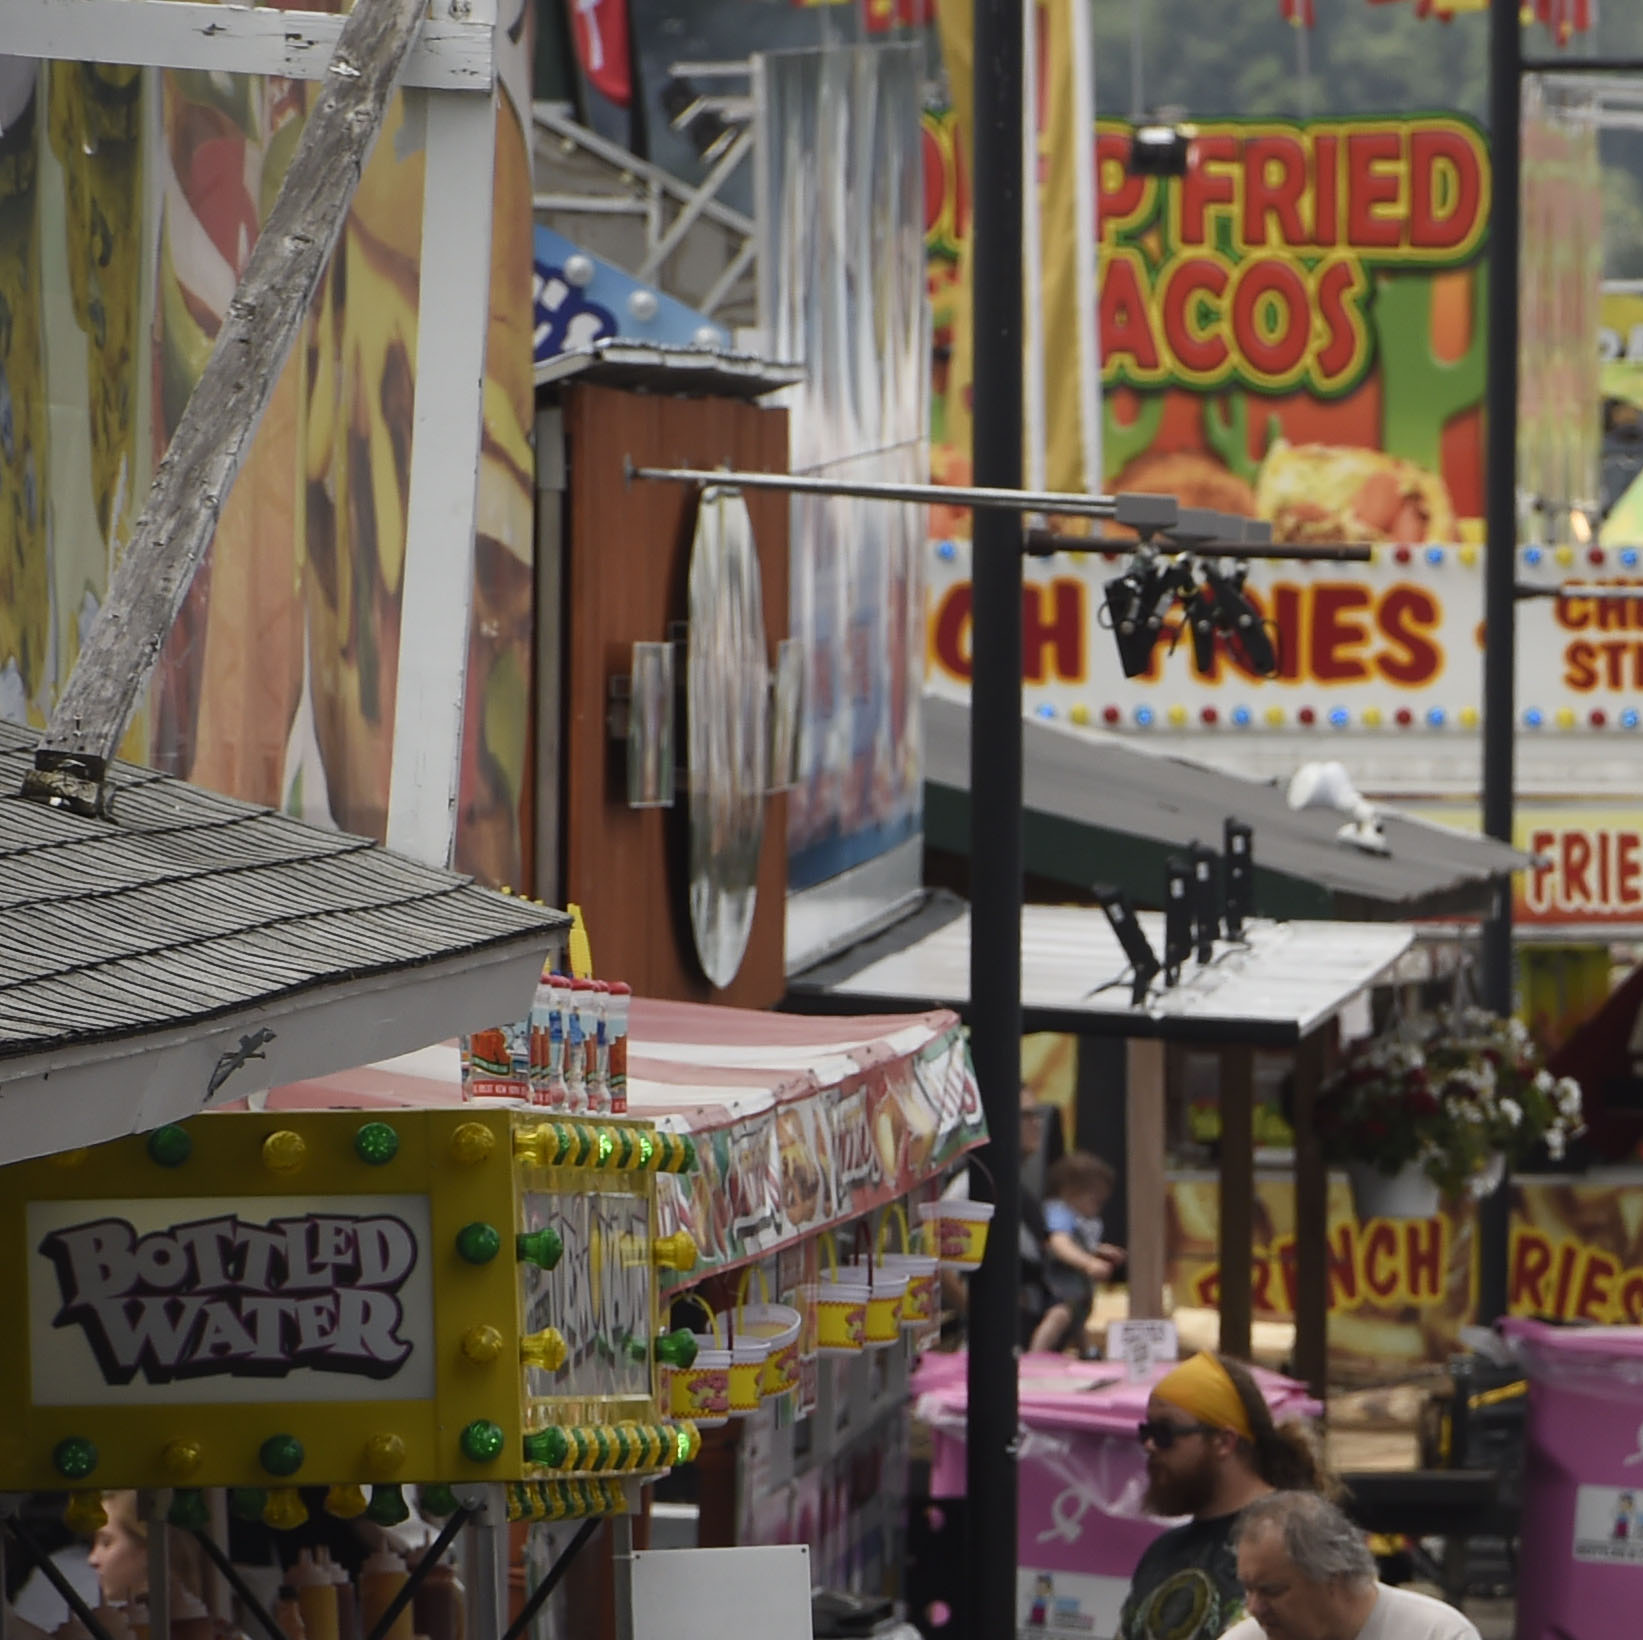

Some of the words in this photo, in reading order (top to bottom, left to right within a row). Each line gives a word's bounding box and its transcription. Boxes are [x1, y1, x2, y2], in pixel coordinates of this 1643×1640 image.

[1180, 130, 1481, 248] FRIED
[1100, 258, 1357, 379] ACOS
[40, 1214, 418, 1302] BOTTLED
[53, 1290, 413, 1386] WATER
